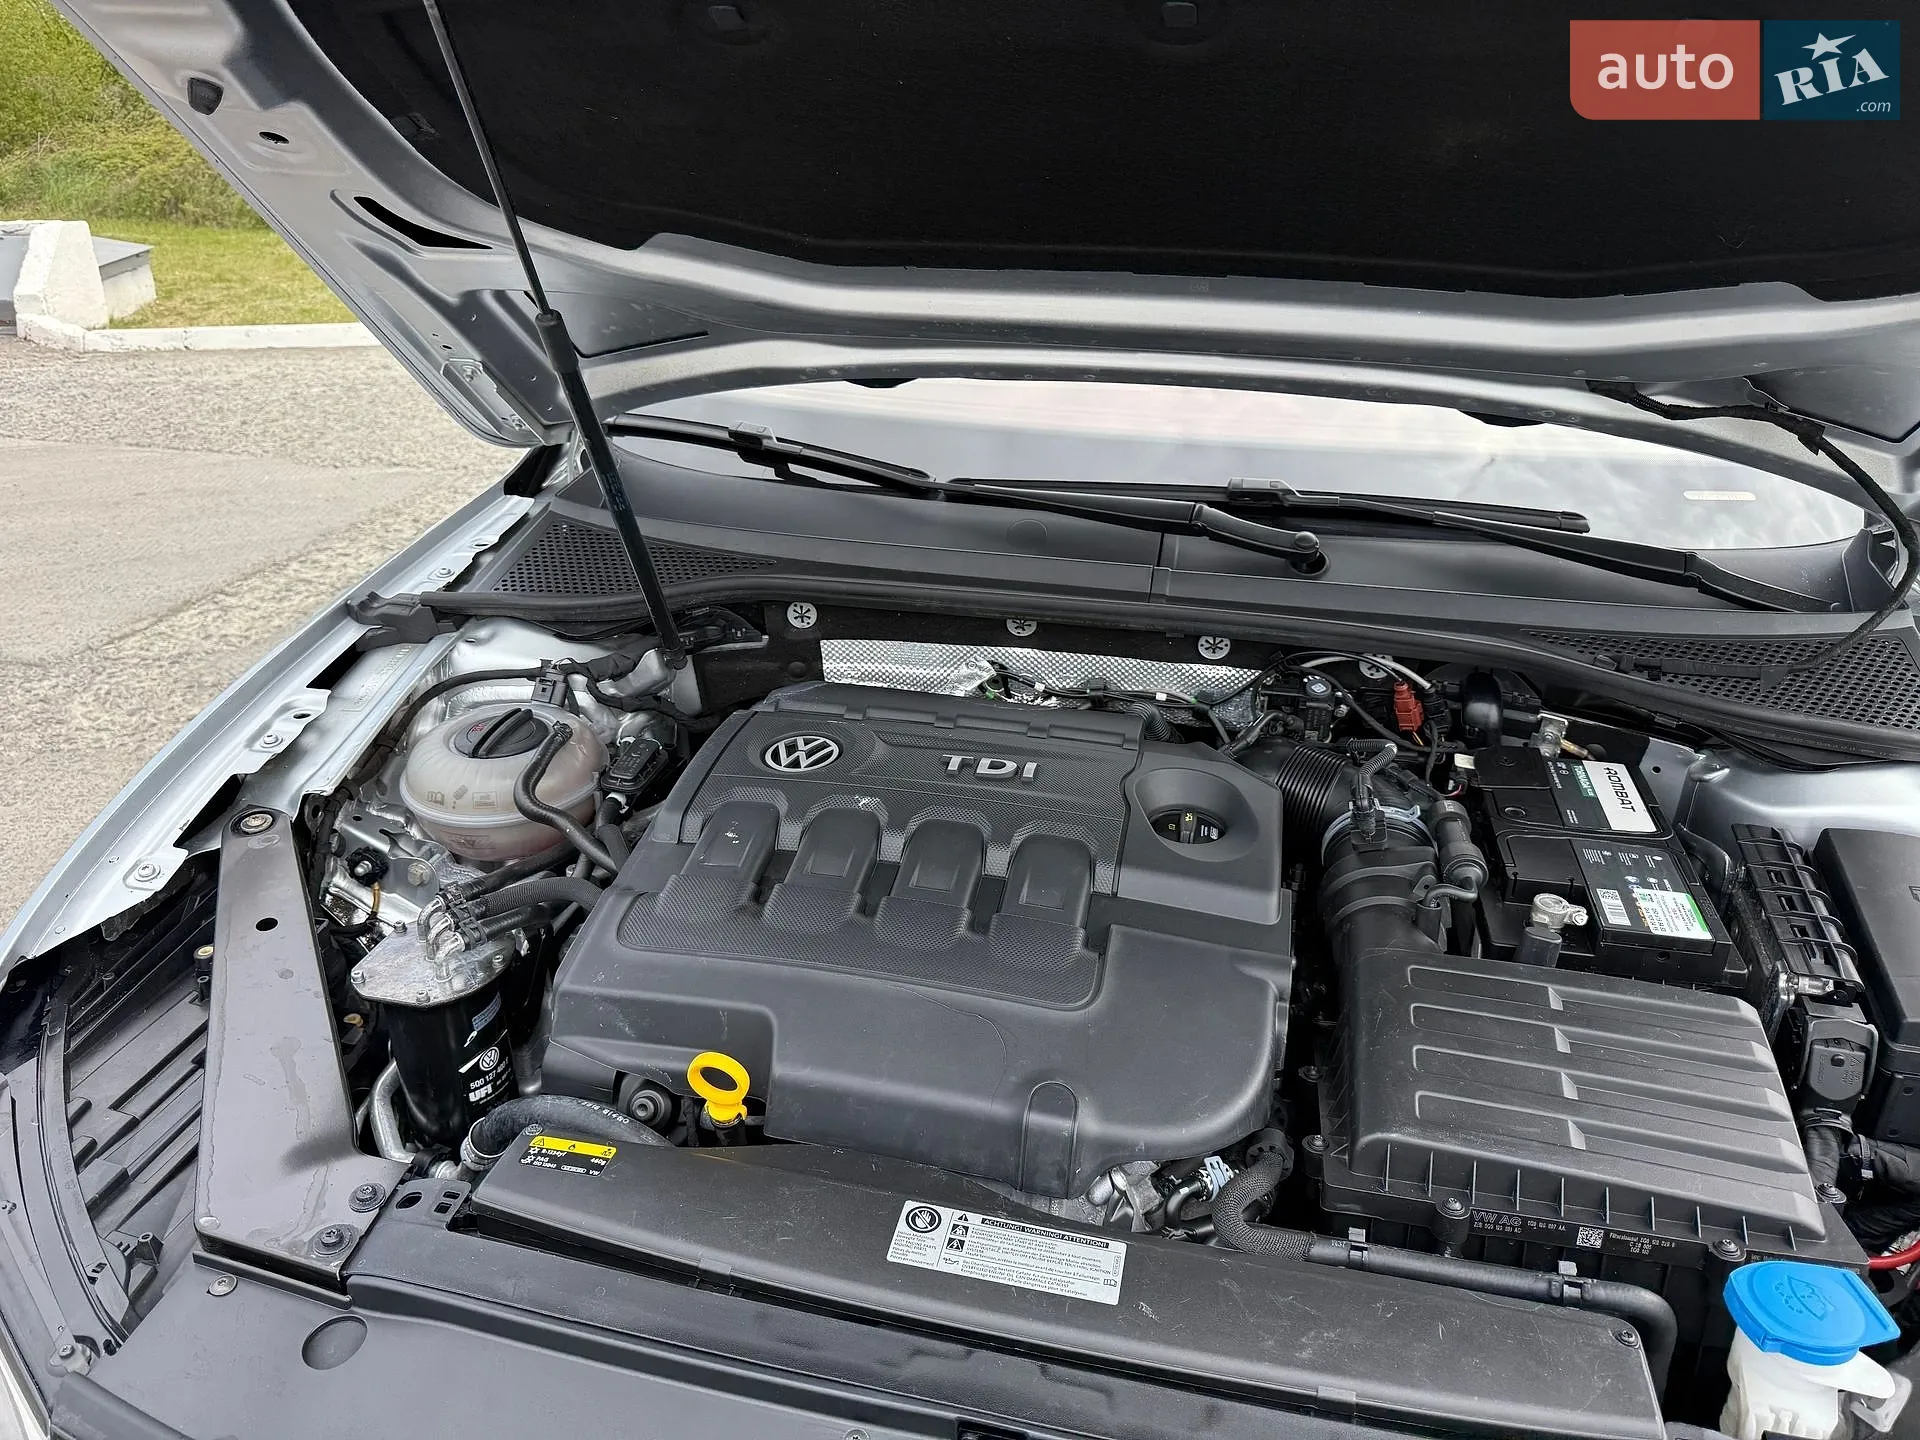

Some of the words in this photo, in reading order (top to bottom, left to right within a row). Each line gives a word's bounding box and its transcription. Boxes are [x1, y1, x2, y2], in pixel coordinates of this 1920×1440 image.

[940, 753, 1037, 783] TDI
[1604, 766, 1636, 813] ROMBAT
[485, 1070, 497, 1082] 127
[469, 1084, 493, 1102] UFI
[1472, 1210, 1498, 1224] VW
[1499, 1215, 1522, 1226] AG
[984, 1219, 1022, 1231] ACHTUNG!
[1024, 1227, 1062, 1239] WARNING!
[1063, 1235, 1107, 1248] ATTENTION!
